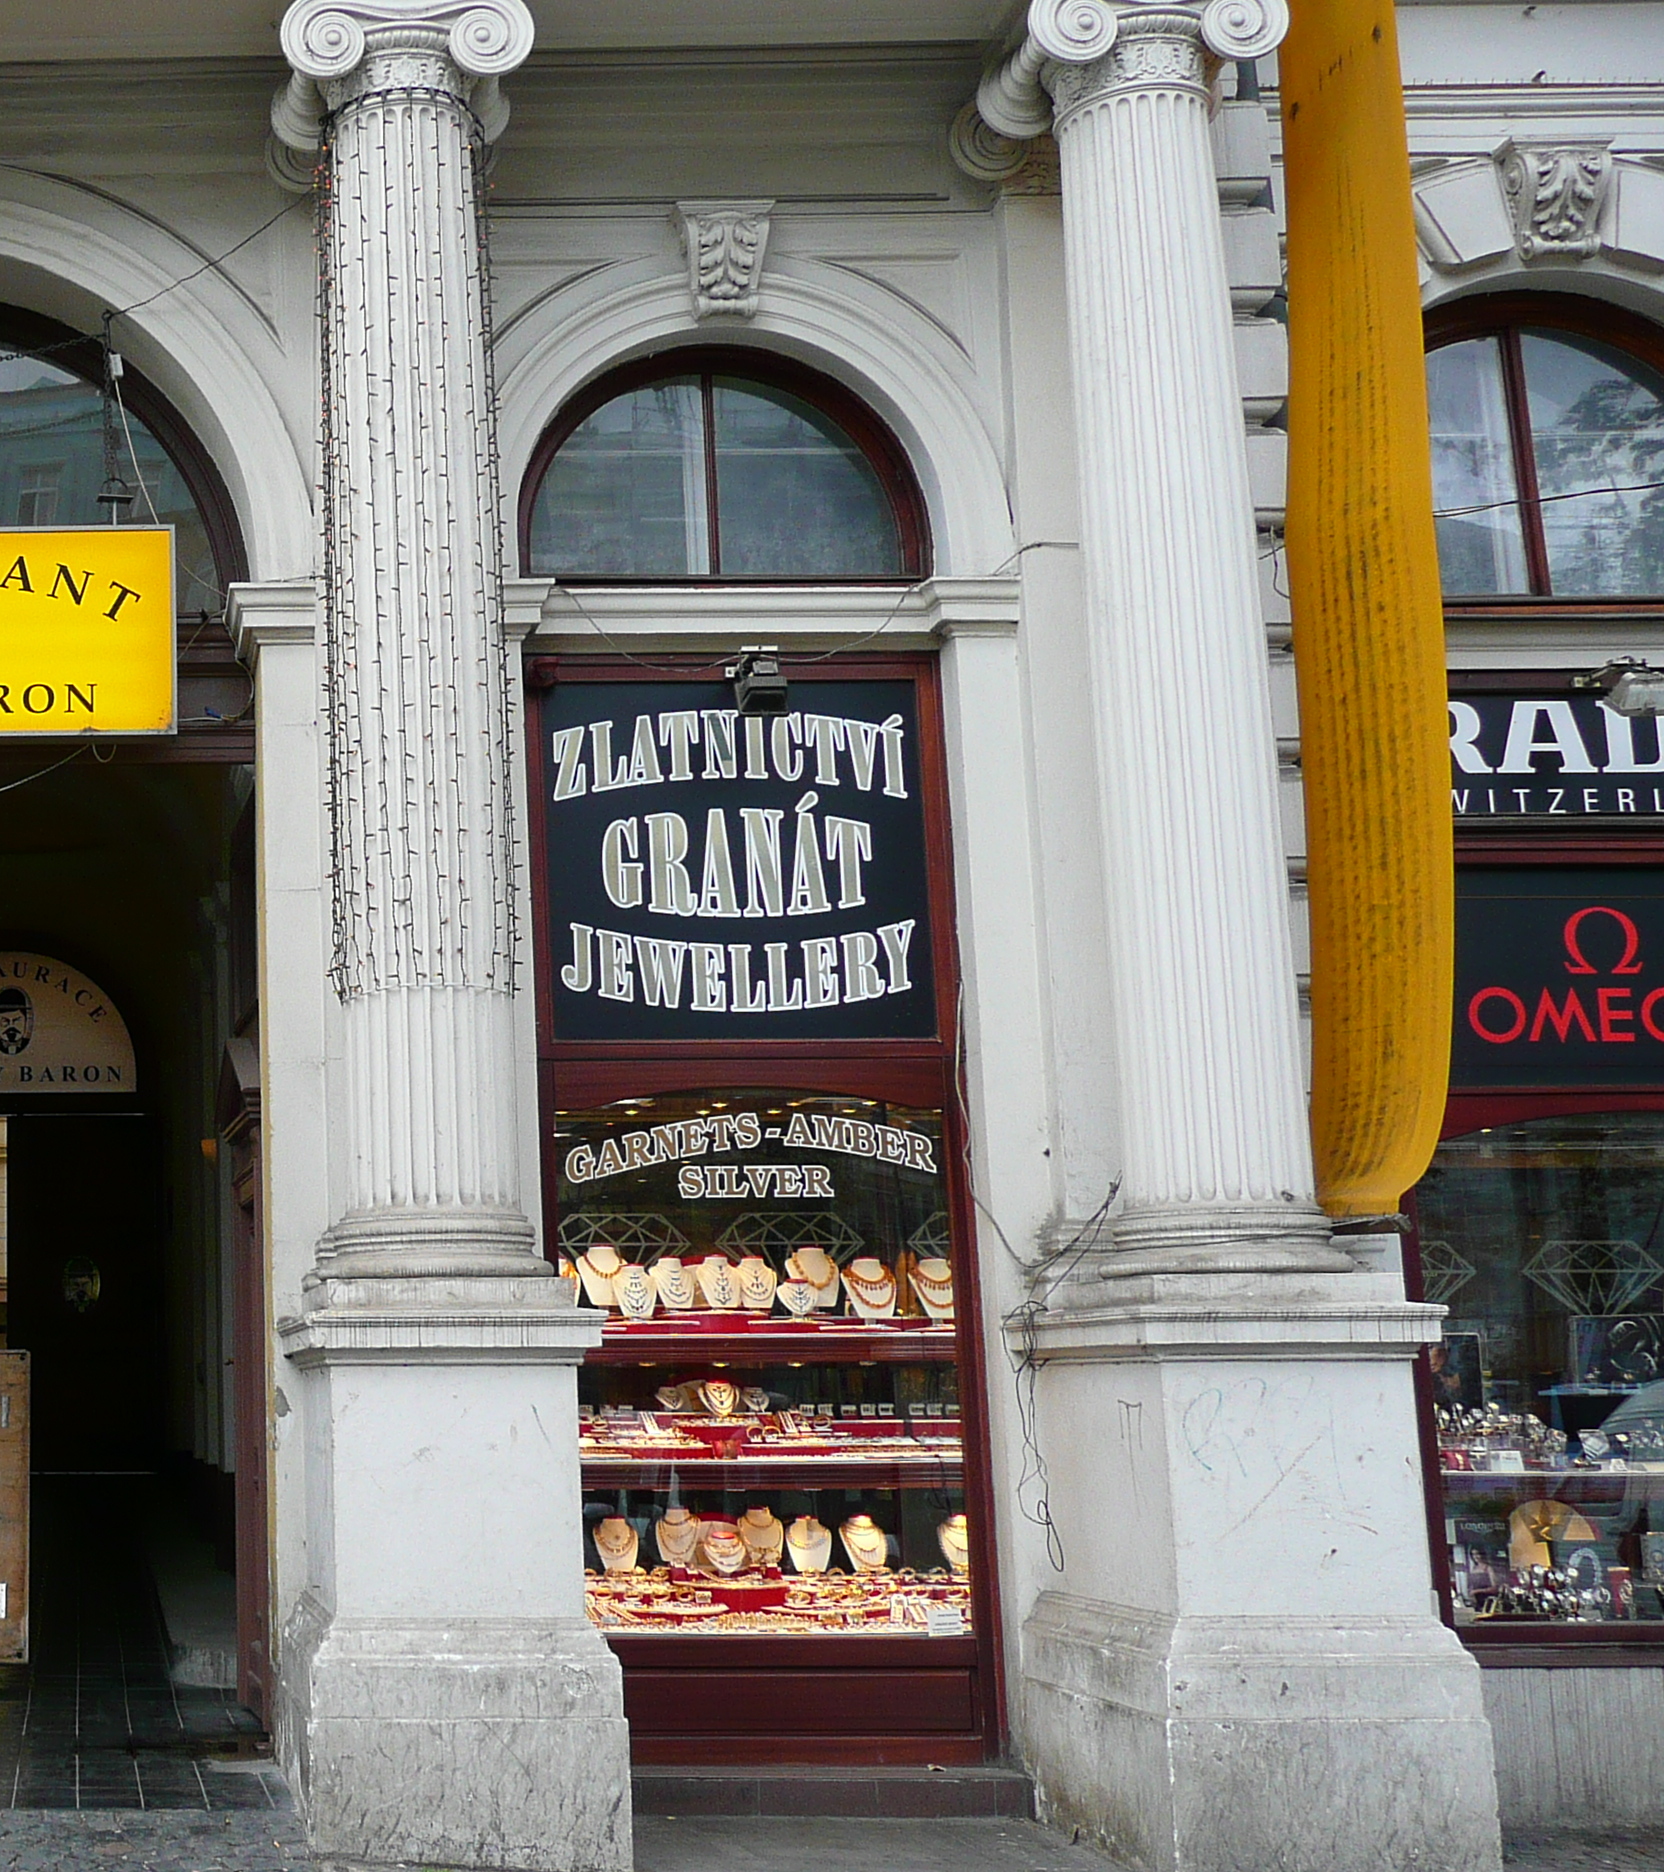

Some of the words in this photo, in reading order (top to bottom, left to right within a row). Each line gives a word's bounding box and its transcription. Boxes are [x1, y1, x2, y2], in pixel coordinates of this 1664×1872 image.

[552, 708, 910, 802] ZLATNICTVÍ
[601, 790, 872, 918] GRANÁT
[560, 918, 916, 1013] JEWELLERY
[19, 1065, 124, 1084] BARON
[678, 1164, 834, 1198] SILVER
